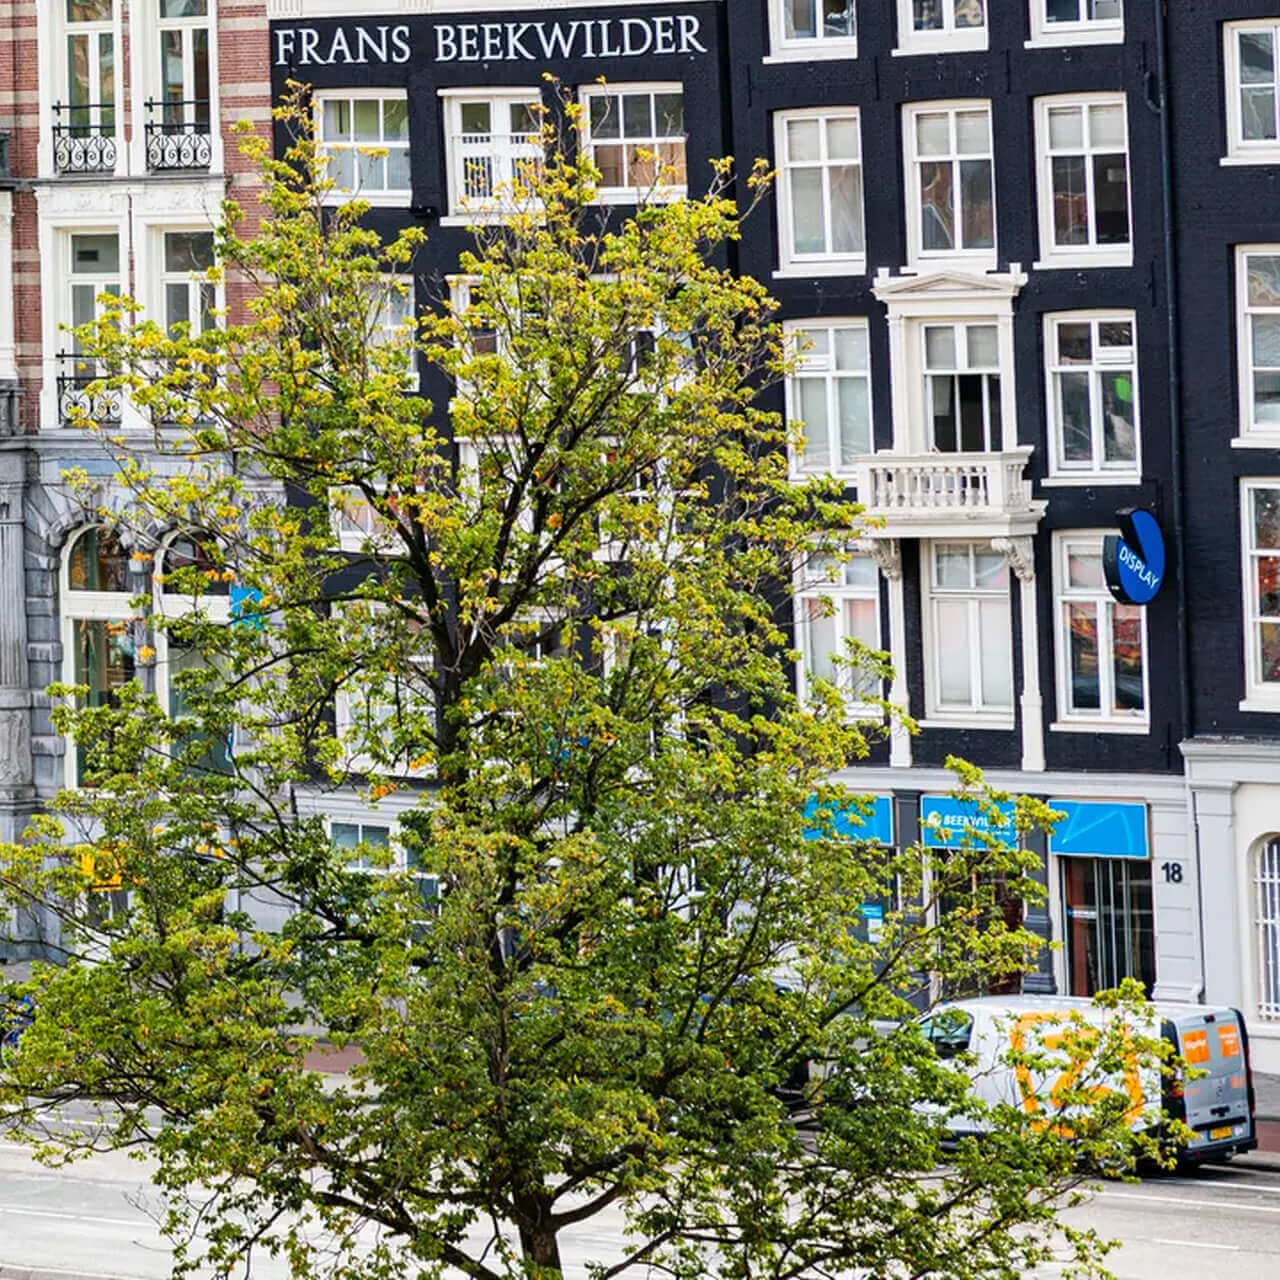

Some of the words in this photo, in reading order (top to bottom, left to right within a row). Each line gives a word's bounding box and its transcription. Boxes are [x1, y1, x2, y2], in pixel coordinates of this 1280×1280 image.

[275, 25, 411, 66] FRANS
[434, 15, 708, 62] BEEKWILDER
[1119, 546, 1159, 589] DISPLAY
[1161, 862, 1183, 883] 18
